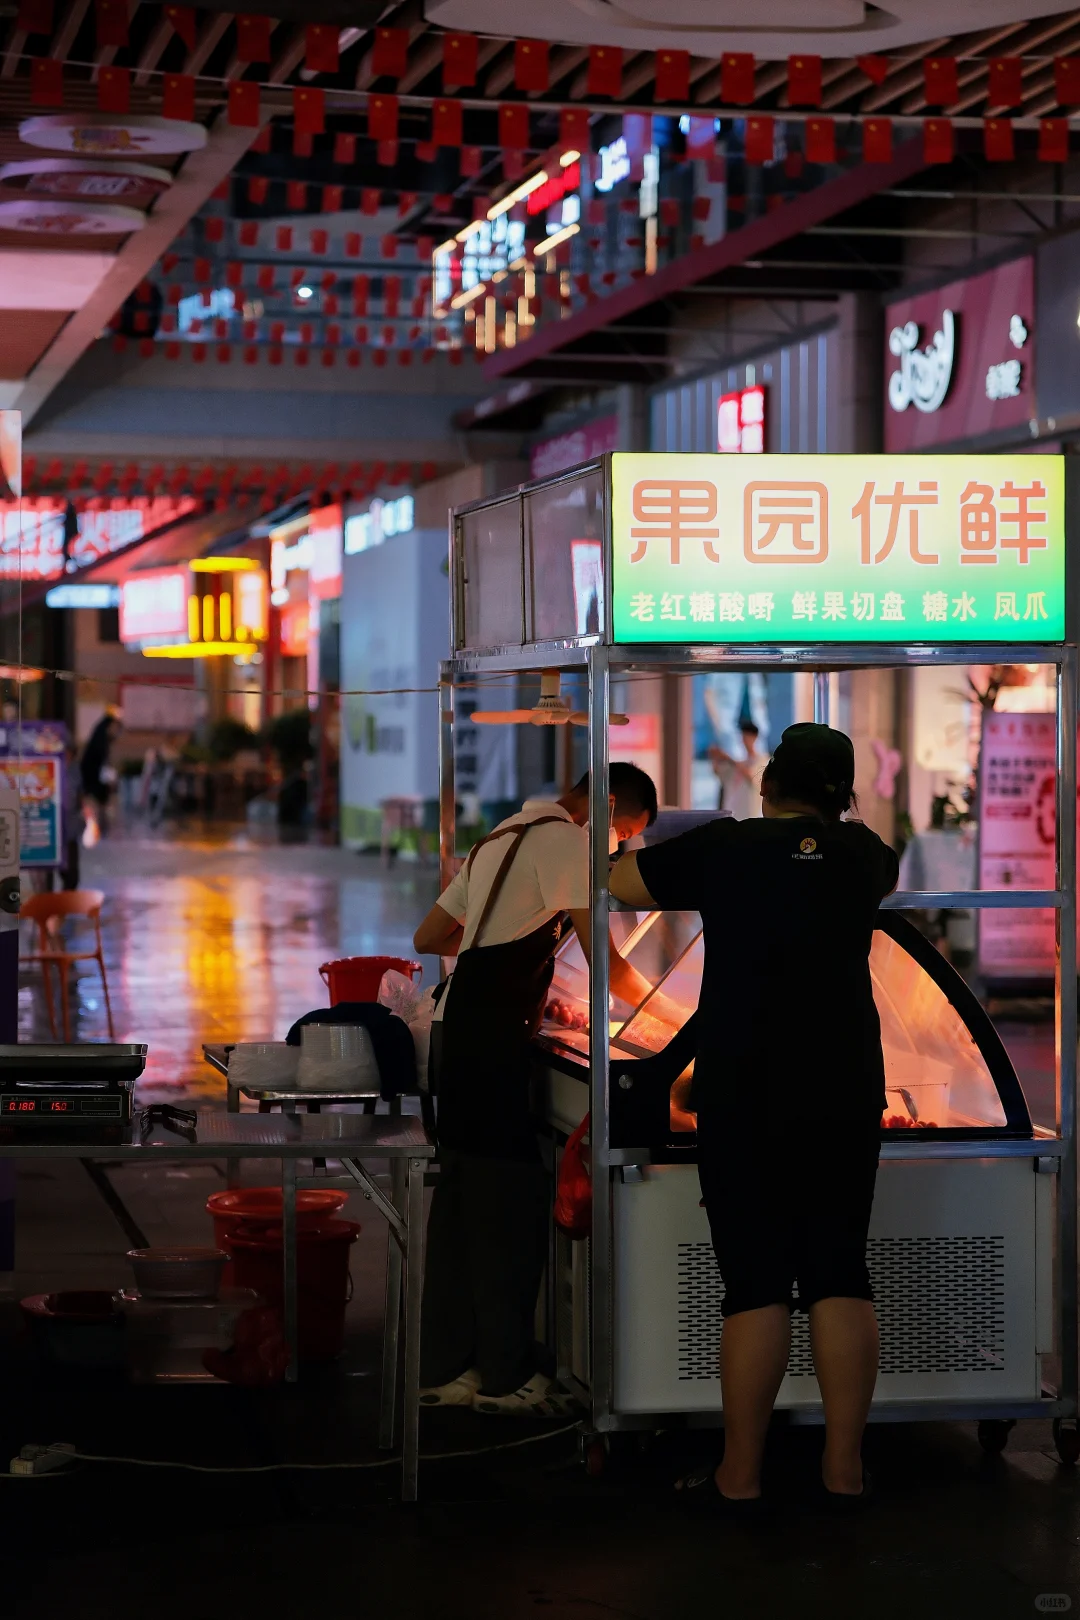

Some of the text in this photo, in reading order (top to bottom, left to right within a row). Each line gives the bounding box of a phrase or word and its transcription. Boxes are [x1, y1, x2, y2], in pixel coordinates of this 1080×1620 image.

[631, 480, 1047, 564] 果园优鲜
[629, 592, 1048, 622] 老红糖酸嘢 鲜果切盘 糖水 凤爪
